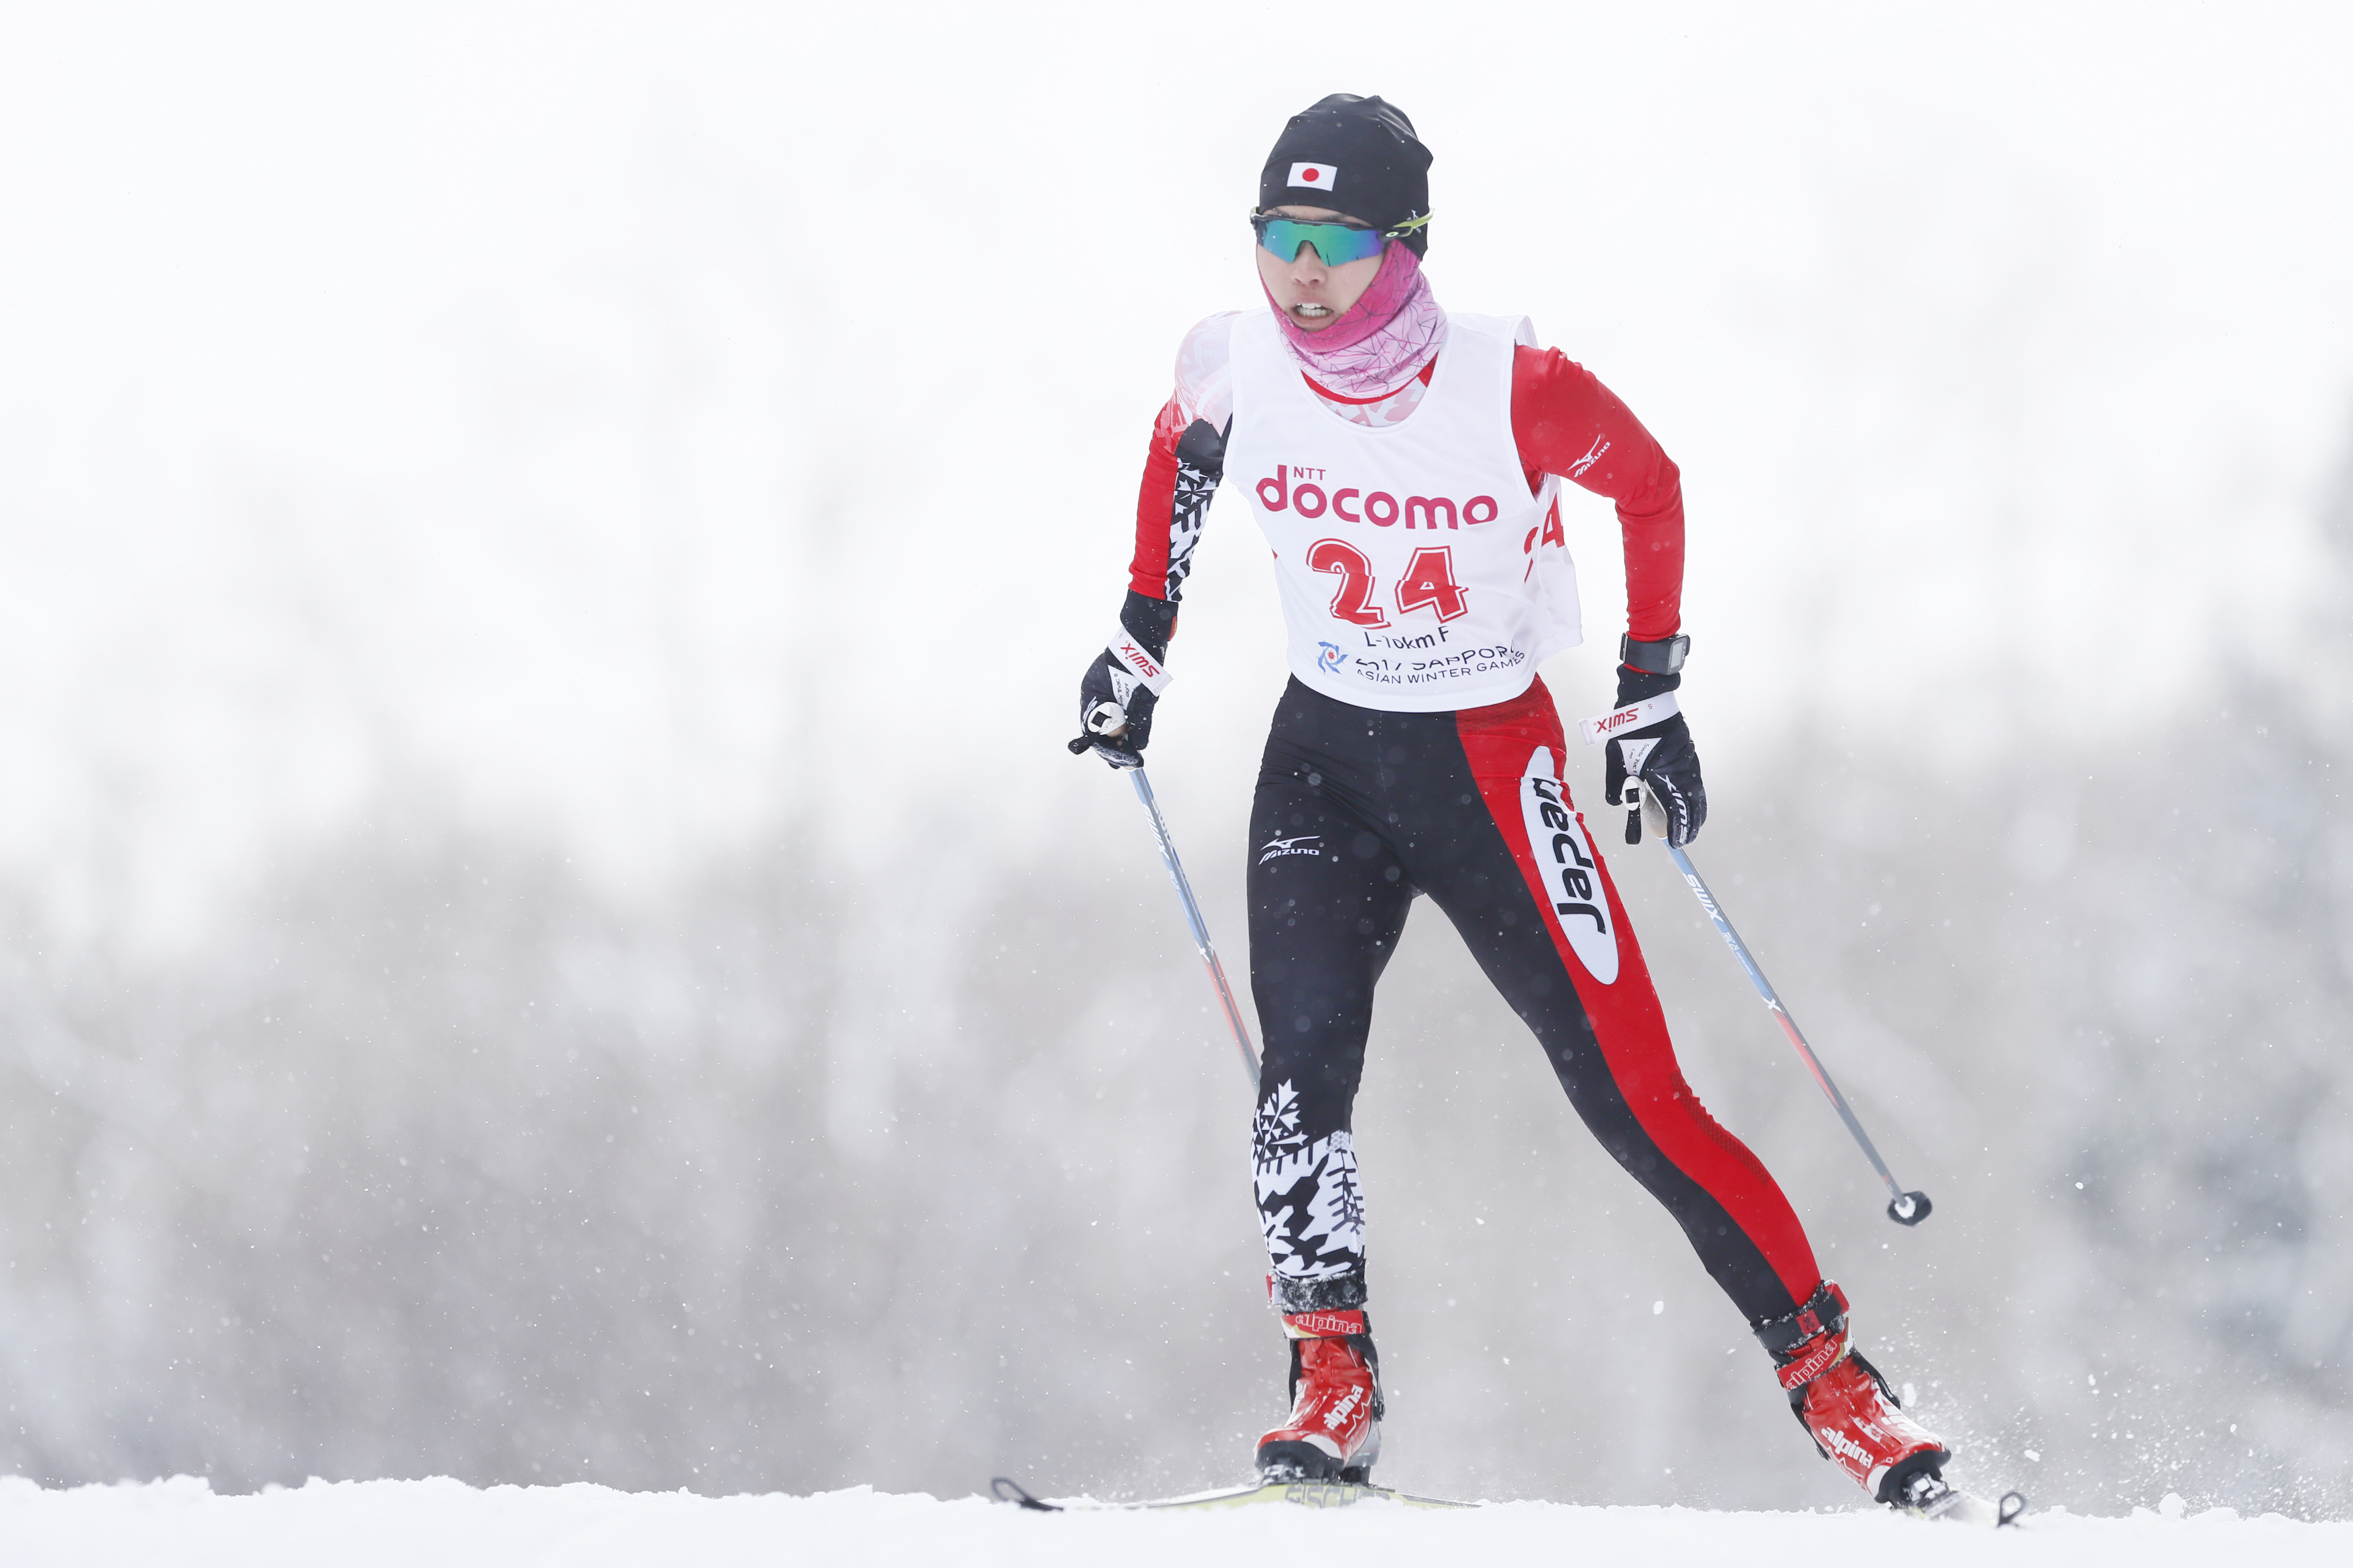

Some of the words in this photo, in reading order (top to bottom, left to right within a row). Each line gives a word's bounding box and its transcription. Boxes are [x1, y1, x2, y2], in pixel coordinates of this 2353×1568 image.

[1293, 465, 1326, 481] NTT
[1255, 464, 1498, 531] docomo
[1305, 538, 1470, 630] 24
[1438, 625, 1450, 642] F
[1357, 669, 1402, 684] ASIAN
[1407, 667, 1472, 684] WINTER
[1476, 650, 1525, 672] GAMES
[1532, 777, 1606, 935] Japan
[1682, 872, 1725, 923] SWIX
[1295, 1313, 1363, 1335] alpina
[1786, 1339, 1837, 1392] alpina
[1323, 1384, 1364, 1431] alpina
[1821, 1427, 1874, 1470] alpina
